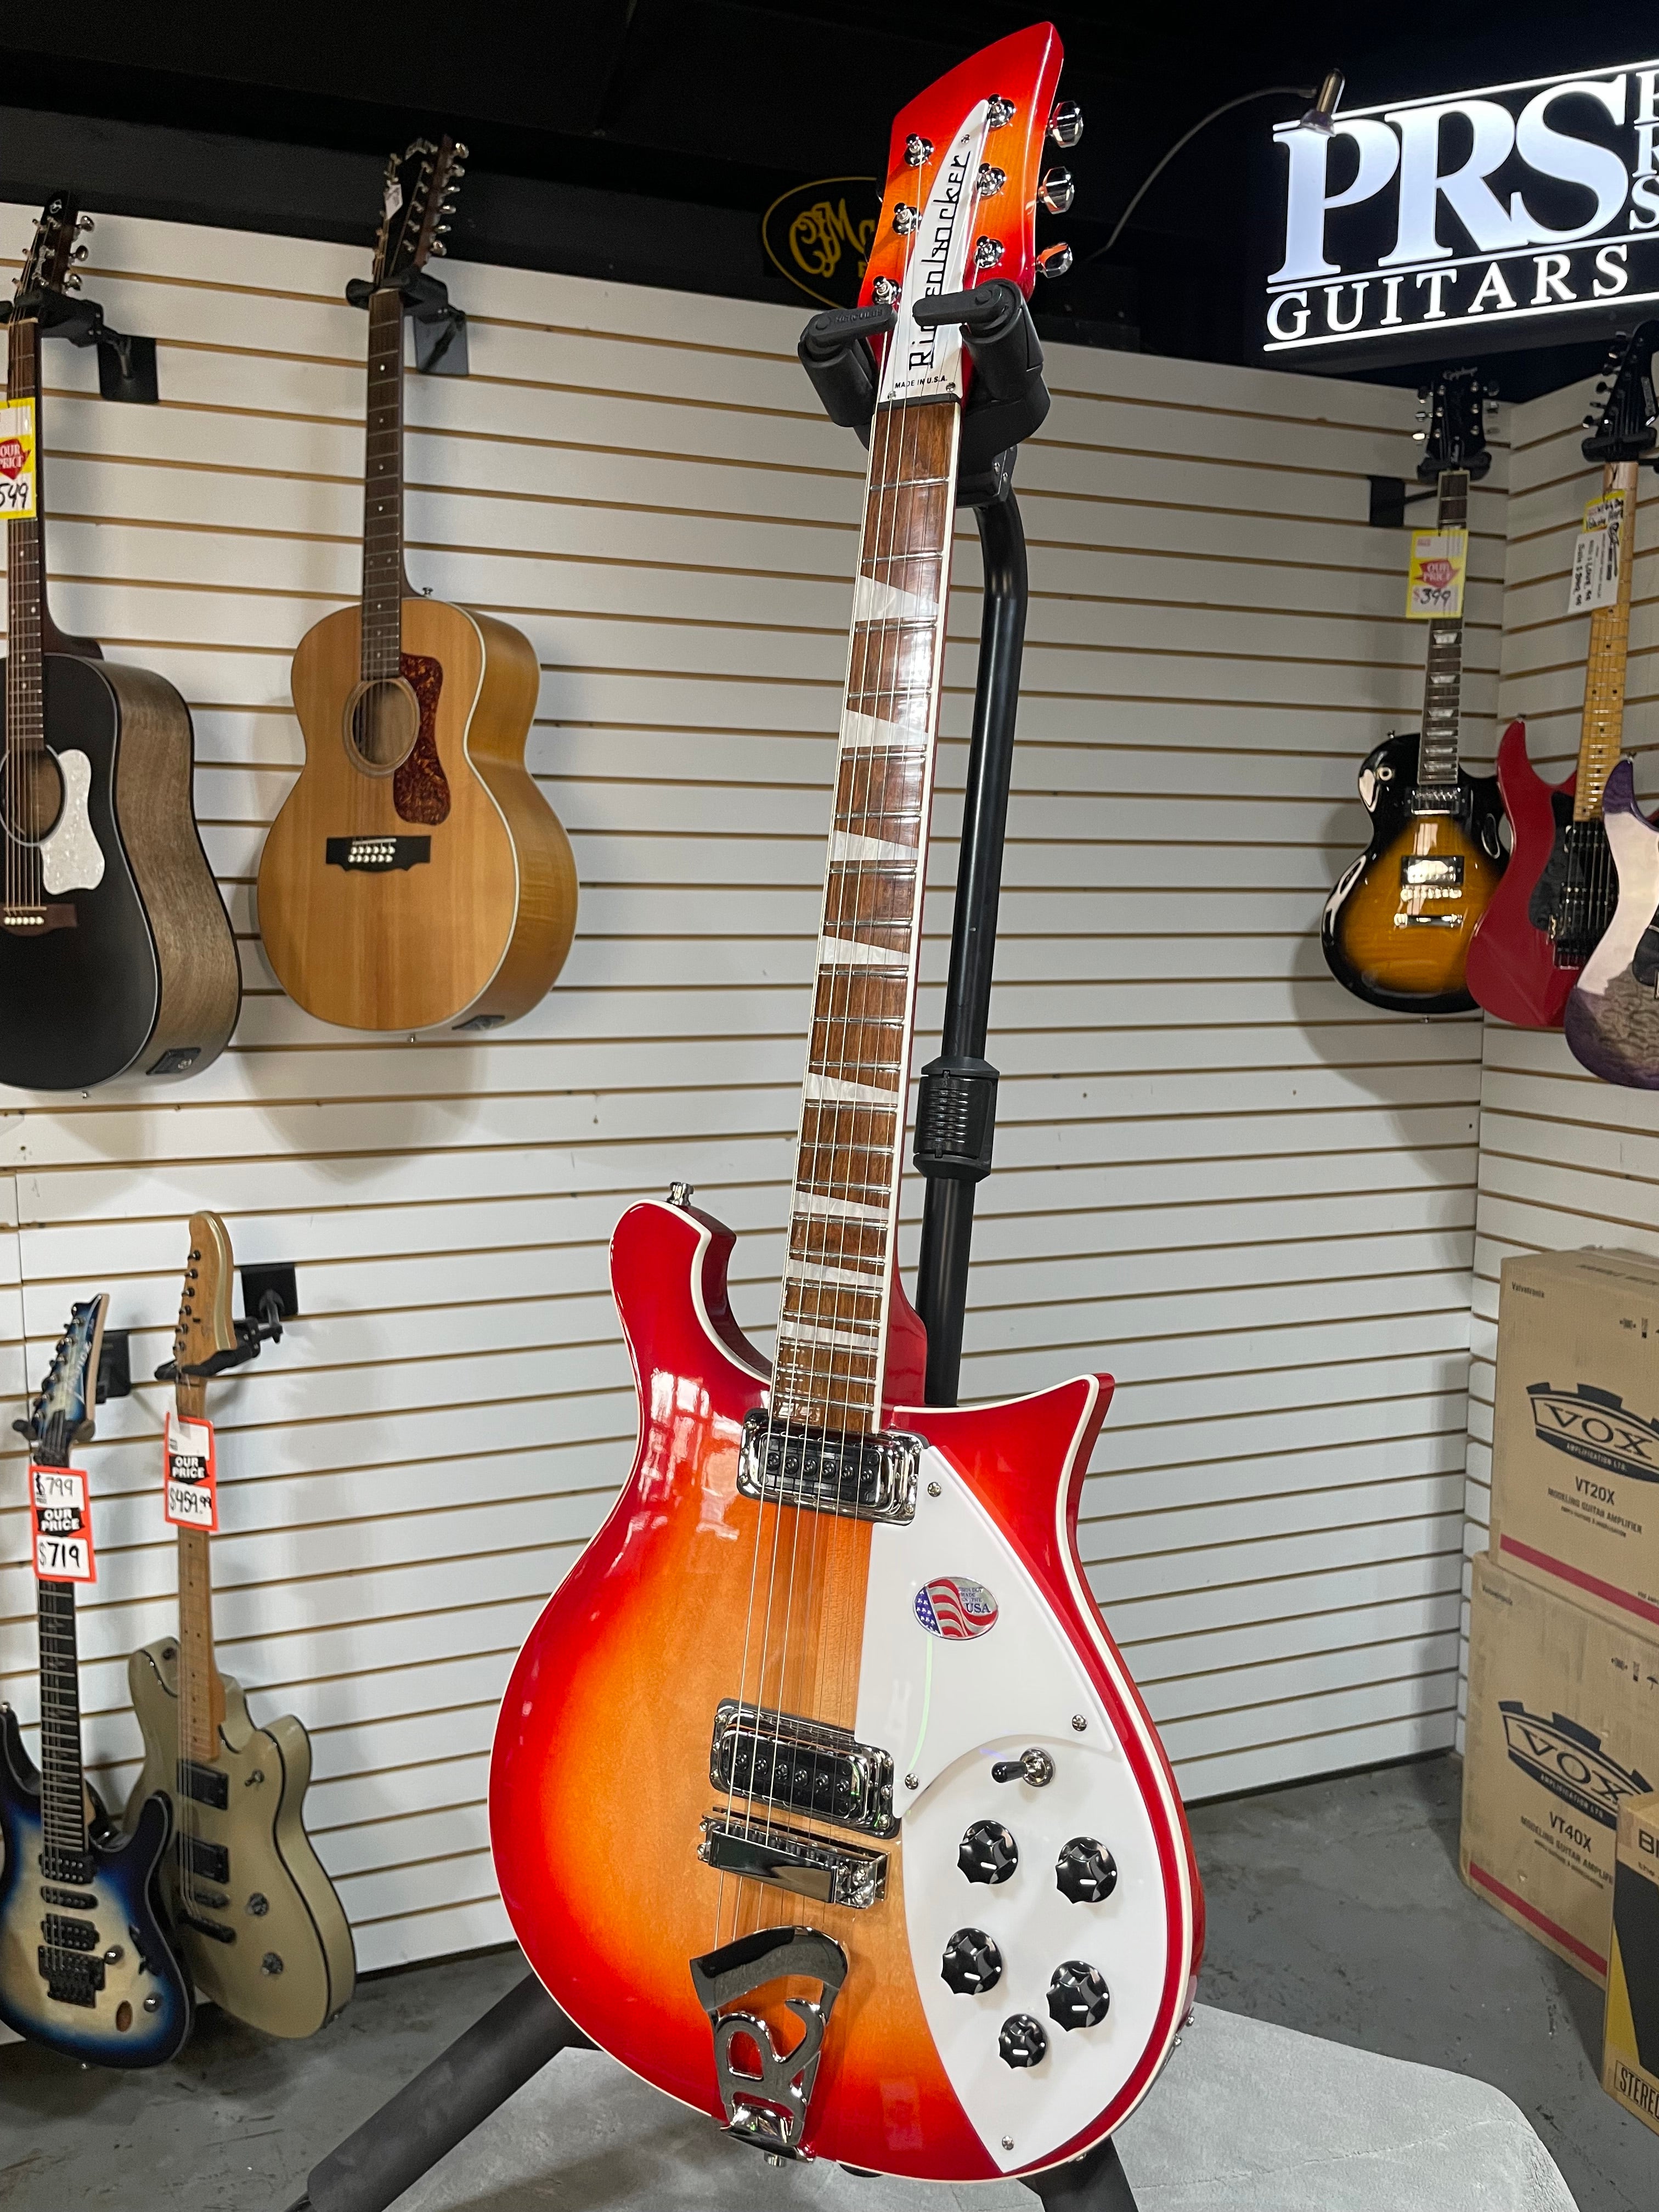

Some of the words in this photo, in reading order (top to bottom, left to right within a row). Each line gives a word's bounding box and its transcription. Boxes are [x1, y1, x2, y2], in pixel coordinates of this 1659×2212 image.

[1268, 74, 1628, 283] PRS
[909, 151, 970, 371] Ricenbacker
[1267, 244, 1628, 340] GUITARS
[895, 380, 915, 388] MADE
[927, 375, 947, 383] U.S.A.
[0, 443, 20, 458] OUR
[1544, 1403, 1652, 1461] VOX
[175, 1455, 199, 1467] OUR
[172, 1466, 205, 1479] PRICE
[1576, 1475, 1615, 1505] VT20X
[41, 1518, 80, 1532] PRICE
[44, 1509, 72, 1521] OUR
[965, 1603, 991, 1613] USA
[1517, 1724, 1633, 1804] VOX
[1550, 1811, 1591, 1853] VT40X
